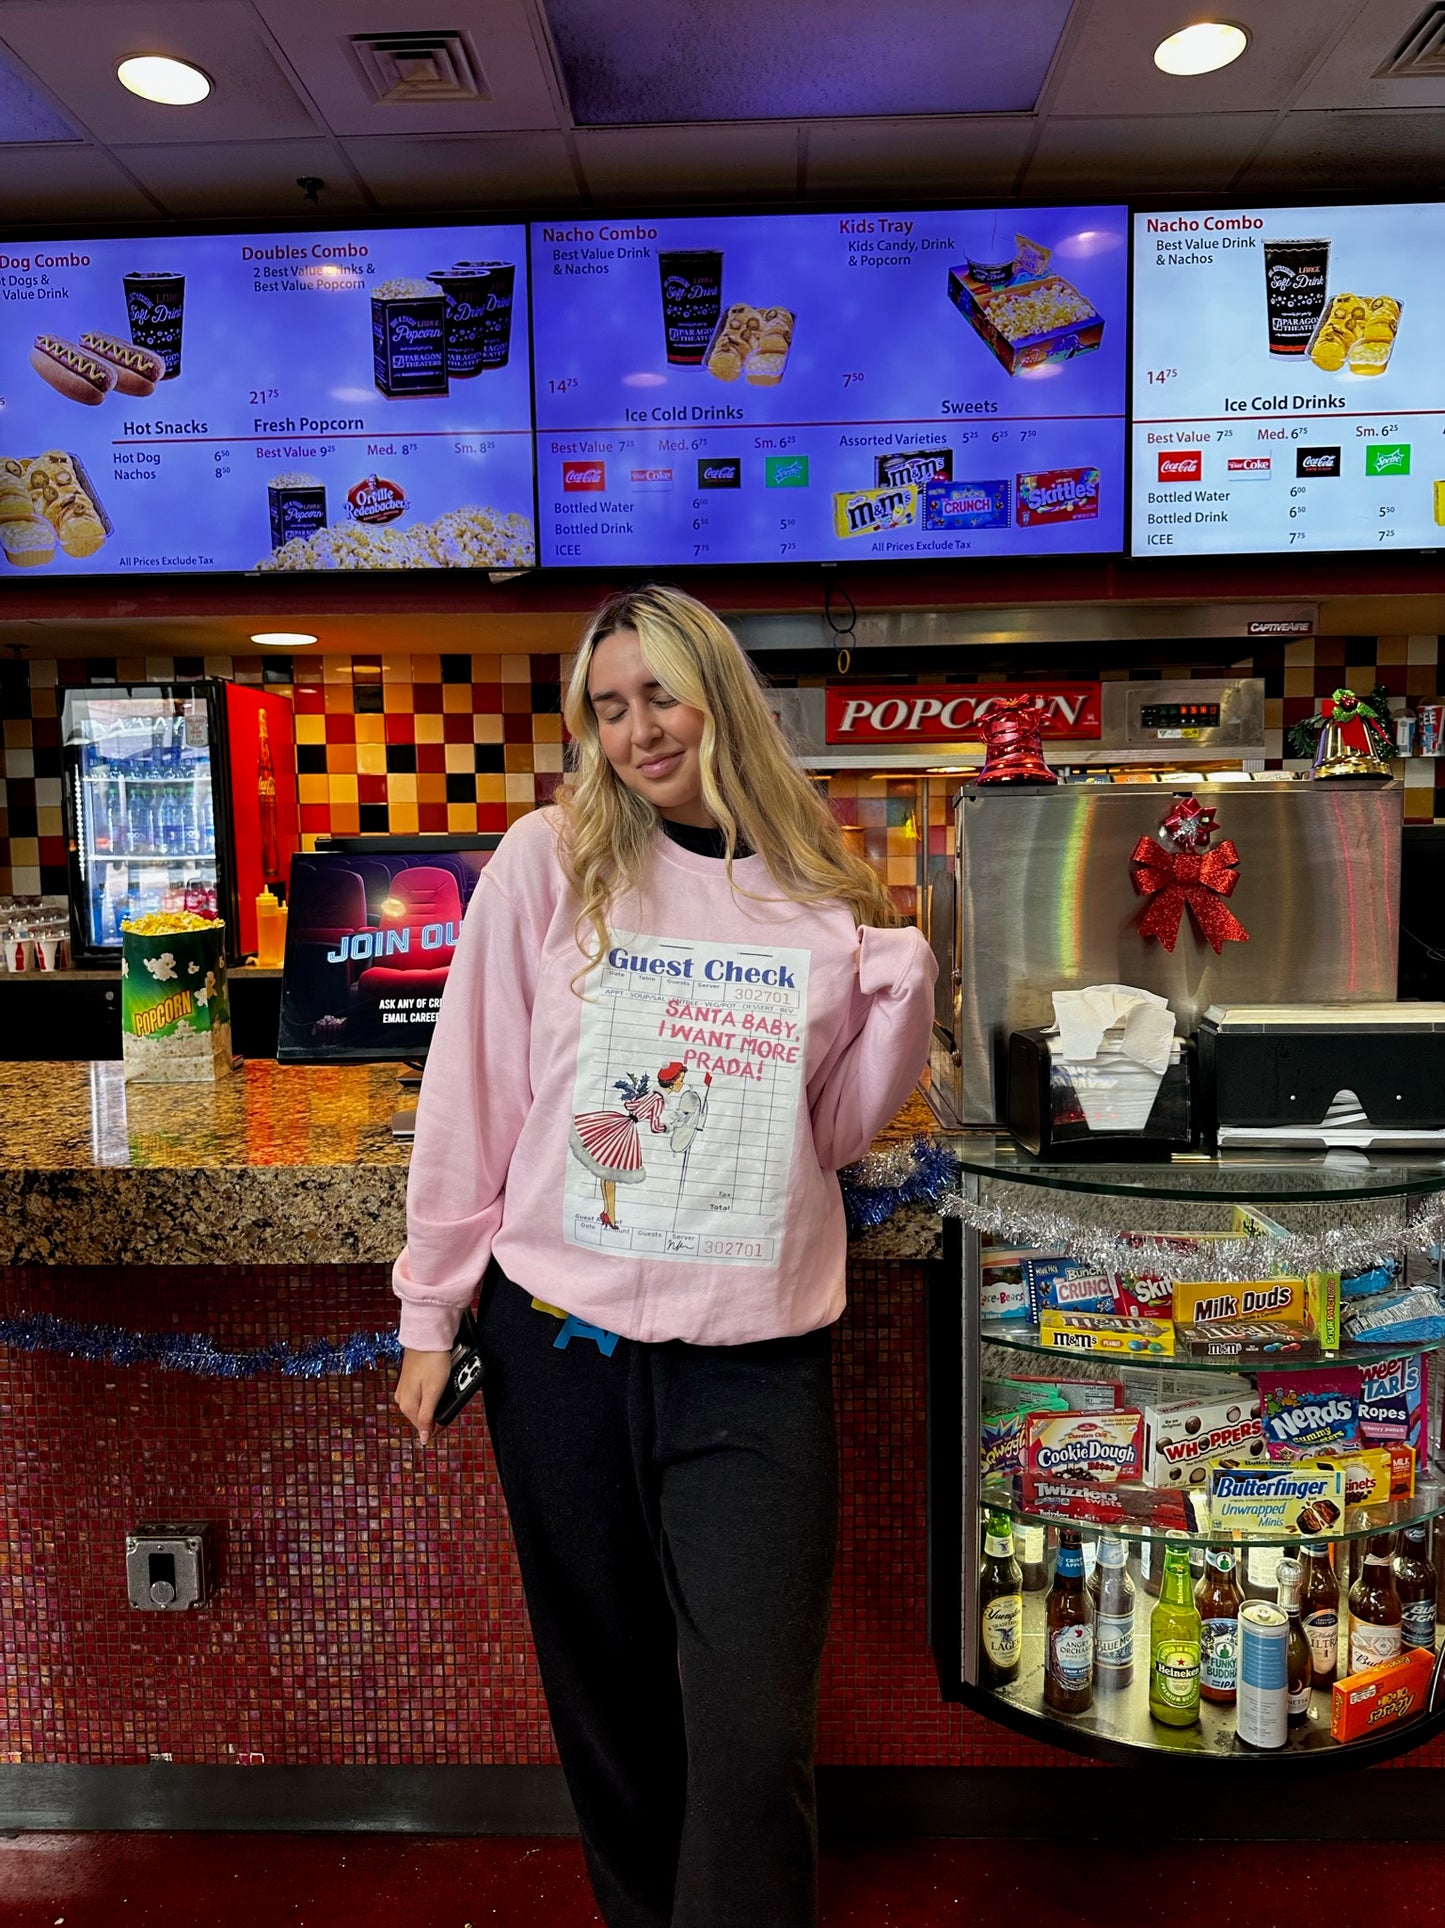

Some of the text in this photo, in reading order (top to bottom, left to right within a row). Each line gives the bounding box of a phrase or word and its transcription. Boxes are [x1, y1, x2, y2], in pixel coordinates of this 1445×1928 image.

[840, 219, 913, 236] Kids Tray
[1147, 216, 1263, 232] Nacho Combo
[543, 226, 657, 242] Nacho Combo
[849, 238, 954, 254] Kids Candy, Drink
[1157, 237, 1255, 251] Best Value Drink
[242, 244, 369, 260] Doubles Combo
[553, 247, 651, 260] Best Value Drink
[1156, 254, 1213, 264] & Nachos
[0, 252, 90, 272] Dog Combo
[553, 262, 609, 274] & Nachos
[849, 254, 911, 268] & Popcorn
[253, 265, 322, 278] 2 Best Value
[9, 275, 38, 288] Dogs
[254, 278, 365, 292] Best Value Popcorn
[1271, 275, 1323, 291] Soft Drink
[3, 287, 69, 299] Value Drink
[942, 399, 998, 414] Sweets
[1225, 395, 1345, 411] Ice Cold Drinks
[625, 405, 744, 422] Ice Cold Drinks
[124, 419, 208, 434] Hot Snacks
[254, 417, 364, 434] Fresh Popcorn
[840, 432, 947, 446] Assorted Varieties
[1147, 426, 1379, 443] Best Value Med. Sm.
[256, 442, 476, 459] Best Value Med. Sm.
[551, 441, 613, 454] Best Value
[113, 452, 161, 466] Hot Dog
[1244, 459, 1269, 469] Coke
[1377, 456, 1401, 467] Sprite
[114, 467, 156, 480] Nachos
[646, 470, 671, 480] Coke
[356, 489, 393, 505] Orville
[1028, 482, 1096, 509] Skittles
[1148, 491, 1230, 503] Bottled Water
[555, 502, 634, 514] Bottled Water
[944, 500, 990, 512] CRUNCH
[1148, 513, 1228, 524] Bottled Drink
[555, 523, 633, 534] Bottled Drink
[872, 540, 971, 552] All Prices Exclude Tax
[1147, 535, 1173, 545] ICEE
[555, 545, 581, 555] ICEE
[120, 555, 214, 566] All Prices Exclude Tax
[327, 928, 409, 963] JOIN
[609, 948, 795, 988] Guest Check
[734, 988, 791, 1004] 302701
[380, 999, 426, 1009] ASK ANY OF
[135, 990, 192, 1036] POPCORN
[383, 1014, 407, 1023] EMAIL
[666, 1000, 800, 1042] SANTA BABY,
[658, 1021, 799, 1063] I WANT MORE
[684, 1050, 763, 1080] PRADA!
[581, 1222, 595, 1230] Date
[638, 1230, 662, 1238] Guests
[704, 1240, 762, 1256] 302701
[1194, 1285, 1292, 1322] Milk Duds
[1327, 1321, 1335, 1344] SOUR
[1358, 1404, 1406, 1421] Ropes
[1166, 1420, 1262, 1461] WHOPPERS
[1088, 1462, 1115, 1471] Bites
[1034, 1483, 1119, 1501] Twizzlers
[1217, 1478, 1327, 1499] Butterfinger
[1085, 1498, 1122, 1507] twists
[1222, 1503, 1286, 1517] Unwrapped
[1259, 1517, 1283, 1526] Minis
[1210, 1658, 1236, 1667] FUNKY
[1158, 1664, 1201, 1677] Heineken
[1220, 1680, 1235, 1688] IPA
